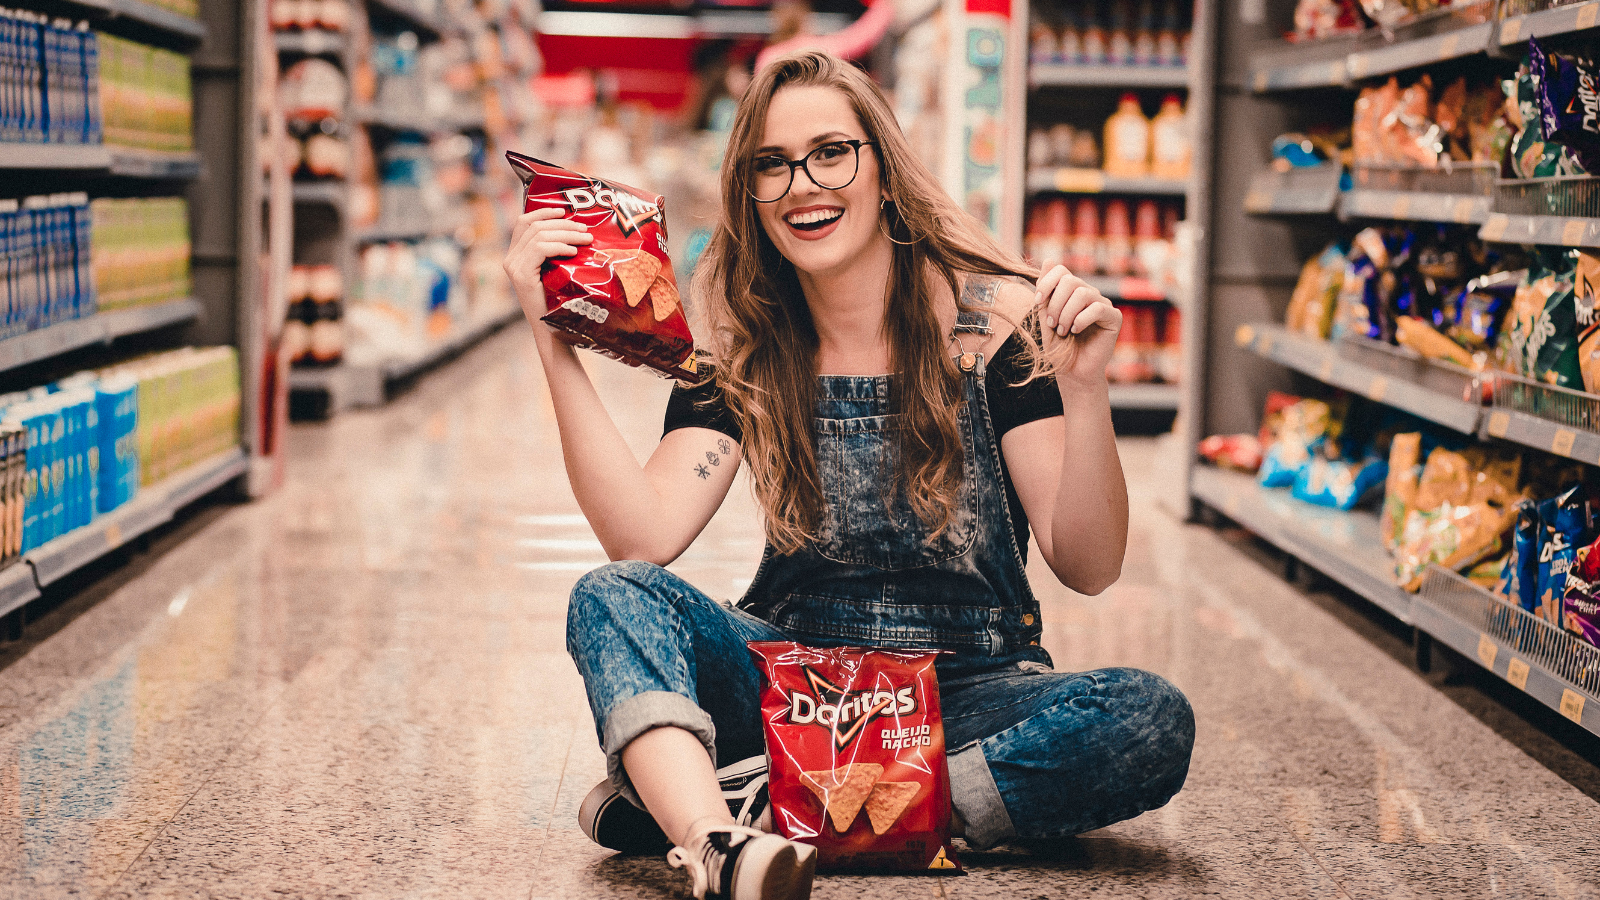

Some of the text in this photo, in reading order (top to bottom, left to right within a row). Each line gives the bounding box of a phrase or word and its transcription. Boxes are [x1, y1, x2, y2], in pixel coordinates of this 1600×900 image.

[687, 357, 696, 369] T
[790, 686, 916, 726] Doritos
[880, 724, 931, 740] QUEIJO
[881, 735, 931, 750] NACHO
[938, 856, 945, 867] T
